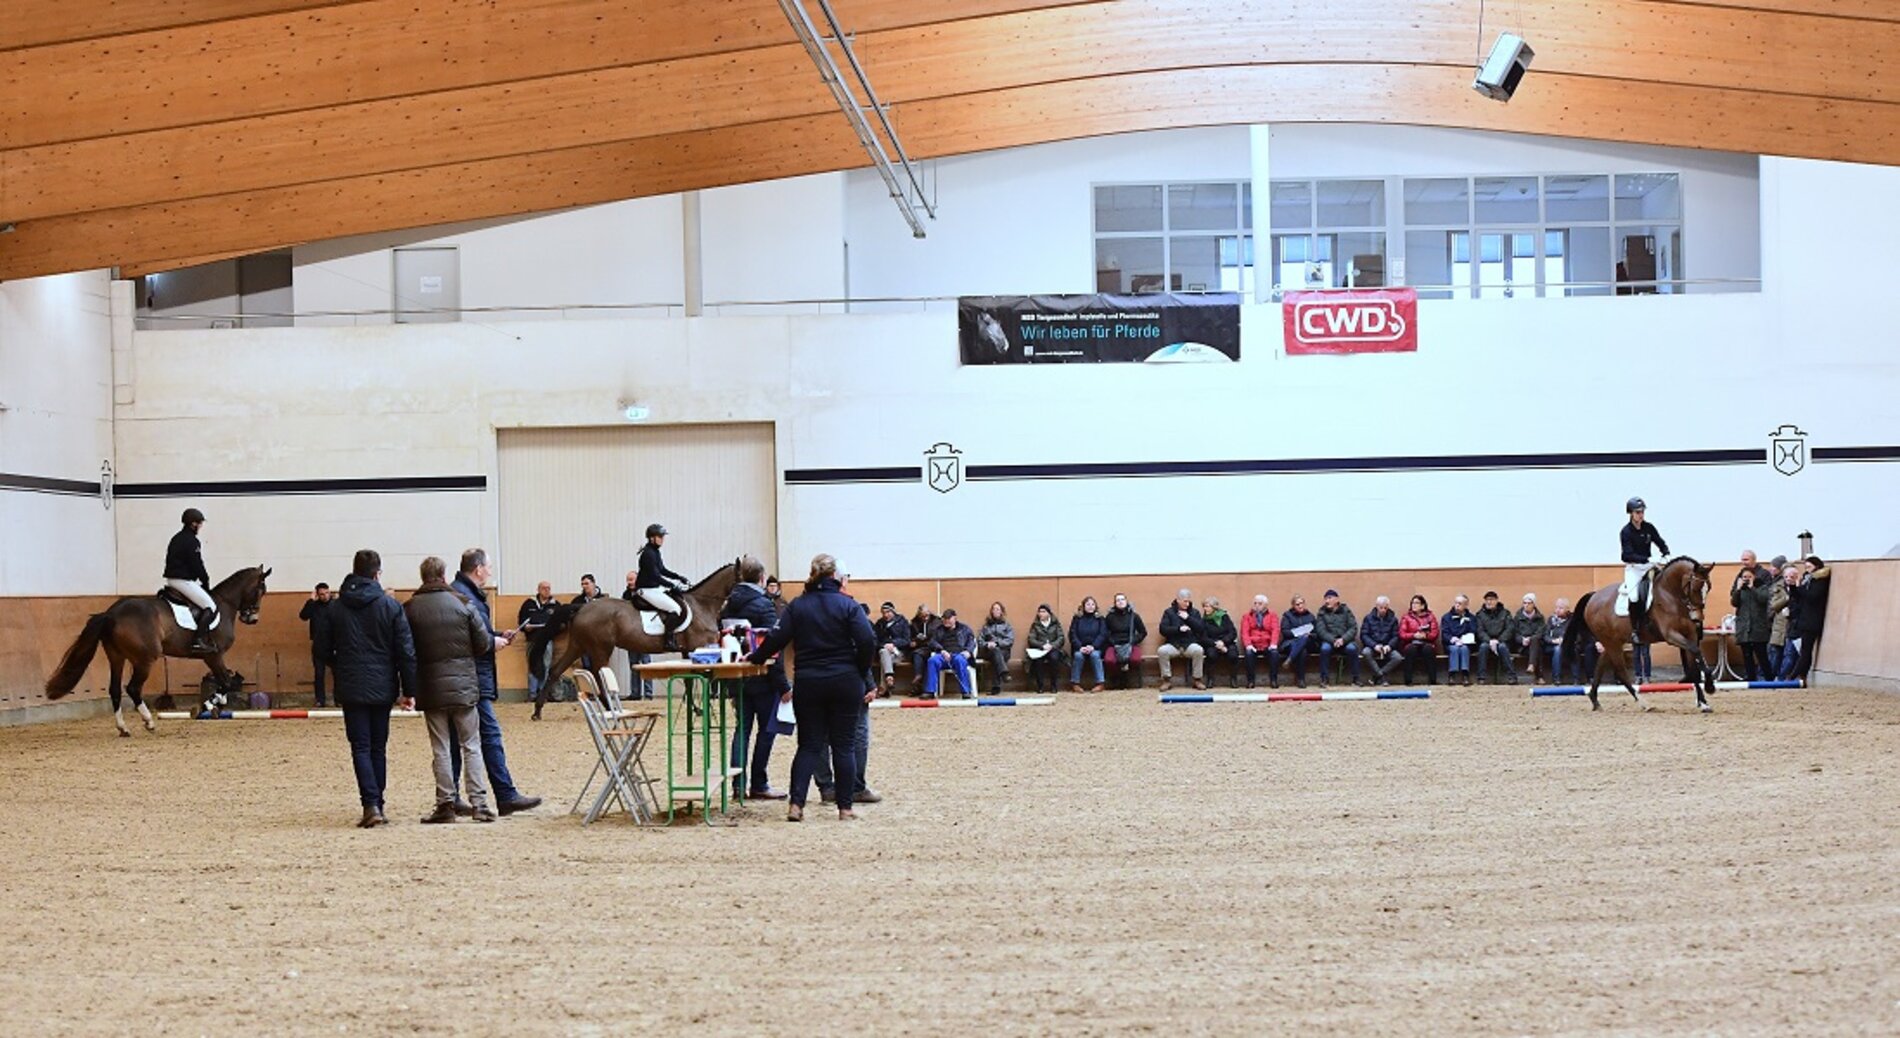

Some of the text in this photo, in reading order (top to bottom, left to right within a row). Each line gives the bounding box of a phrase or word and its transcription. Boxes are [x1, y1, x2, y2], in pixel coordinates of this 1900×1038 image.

[1020, 323, 1160, 340] Wir leben für Pferde
[1302, 307, 1386, 334] CWD
